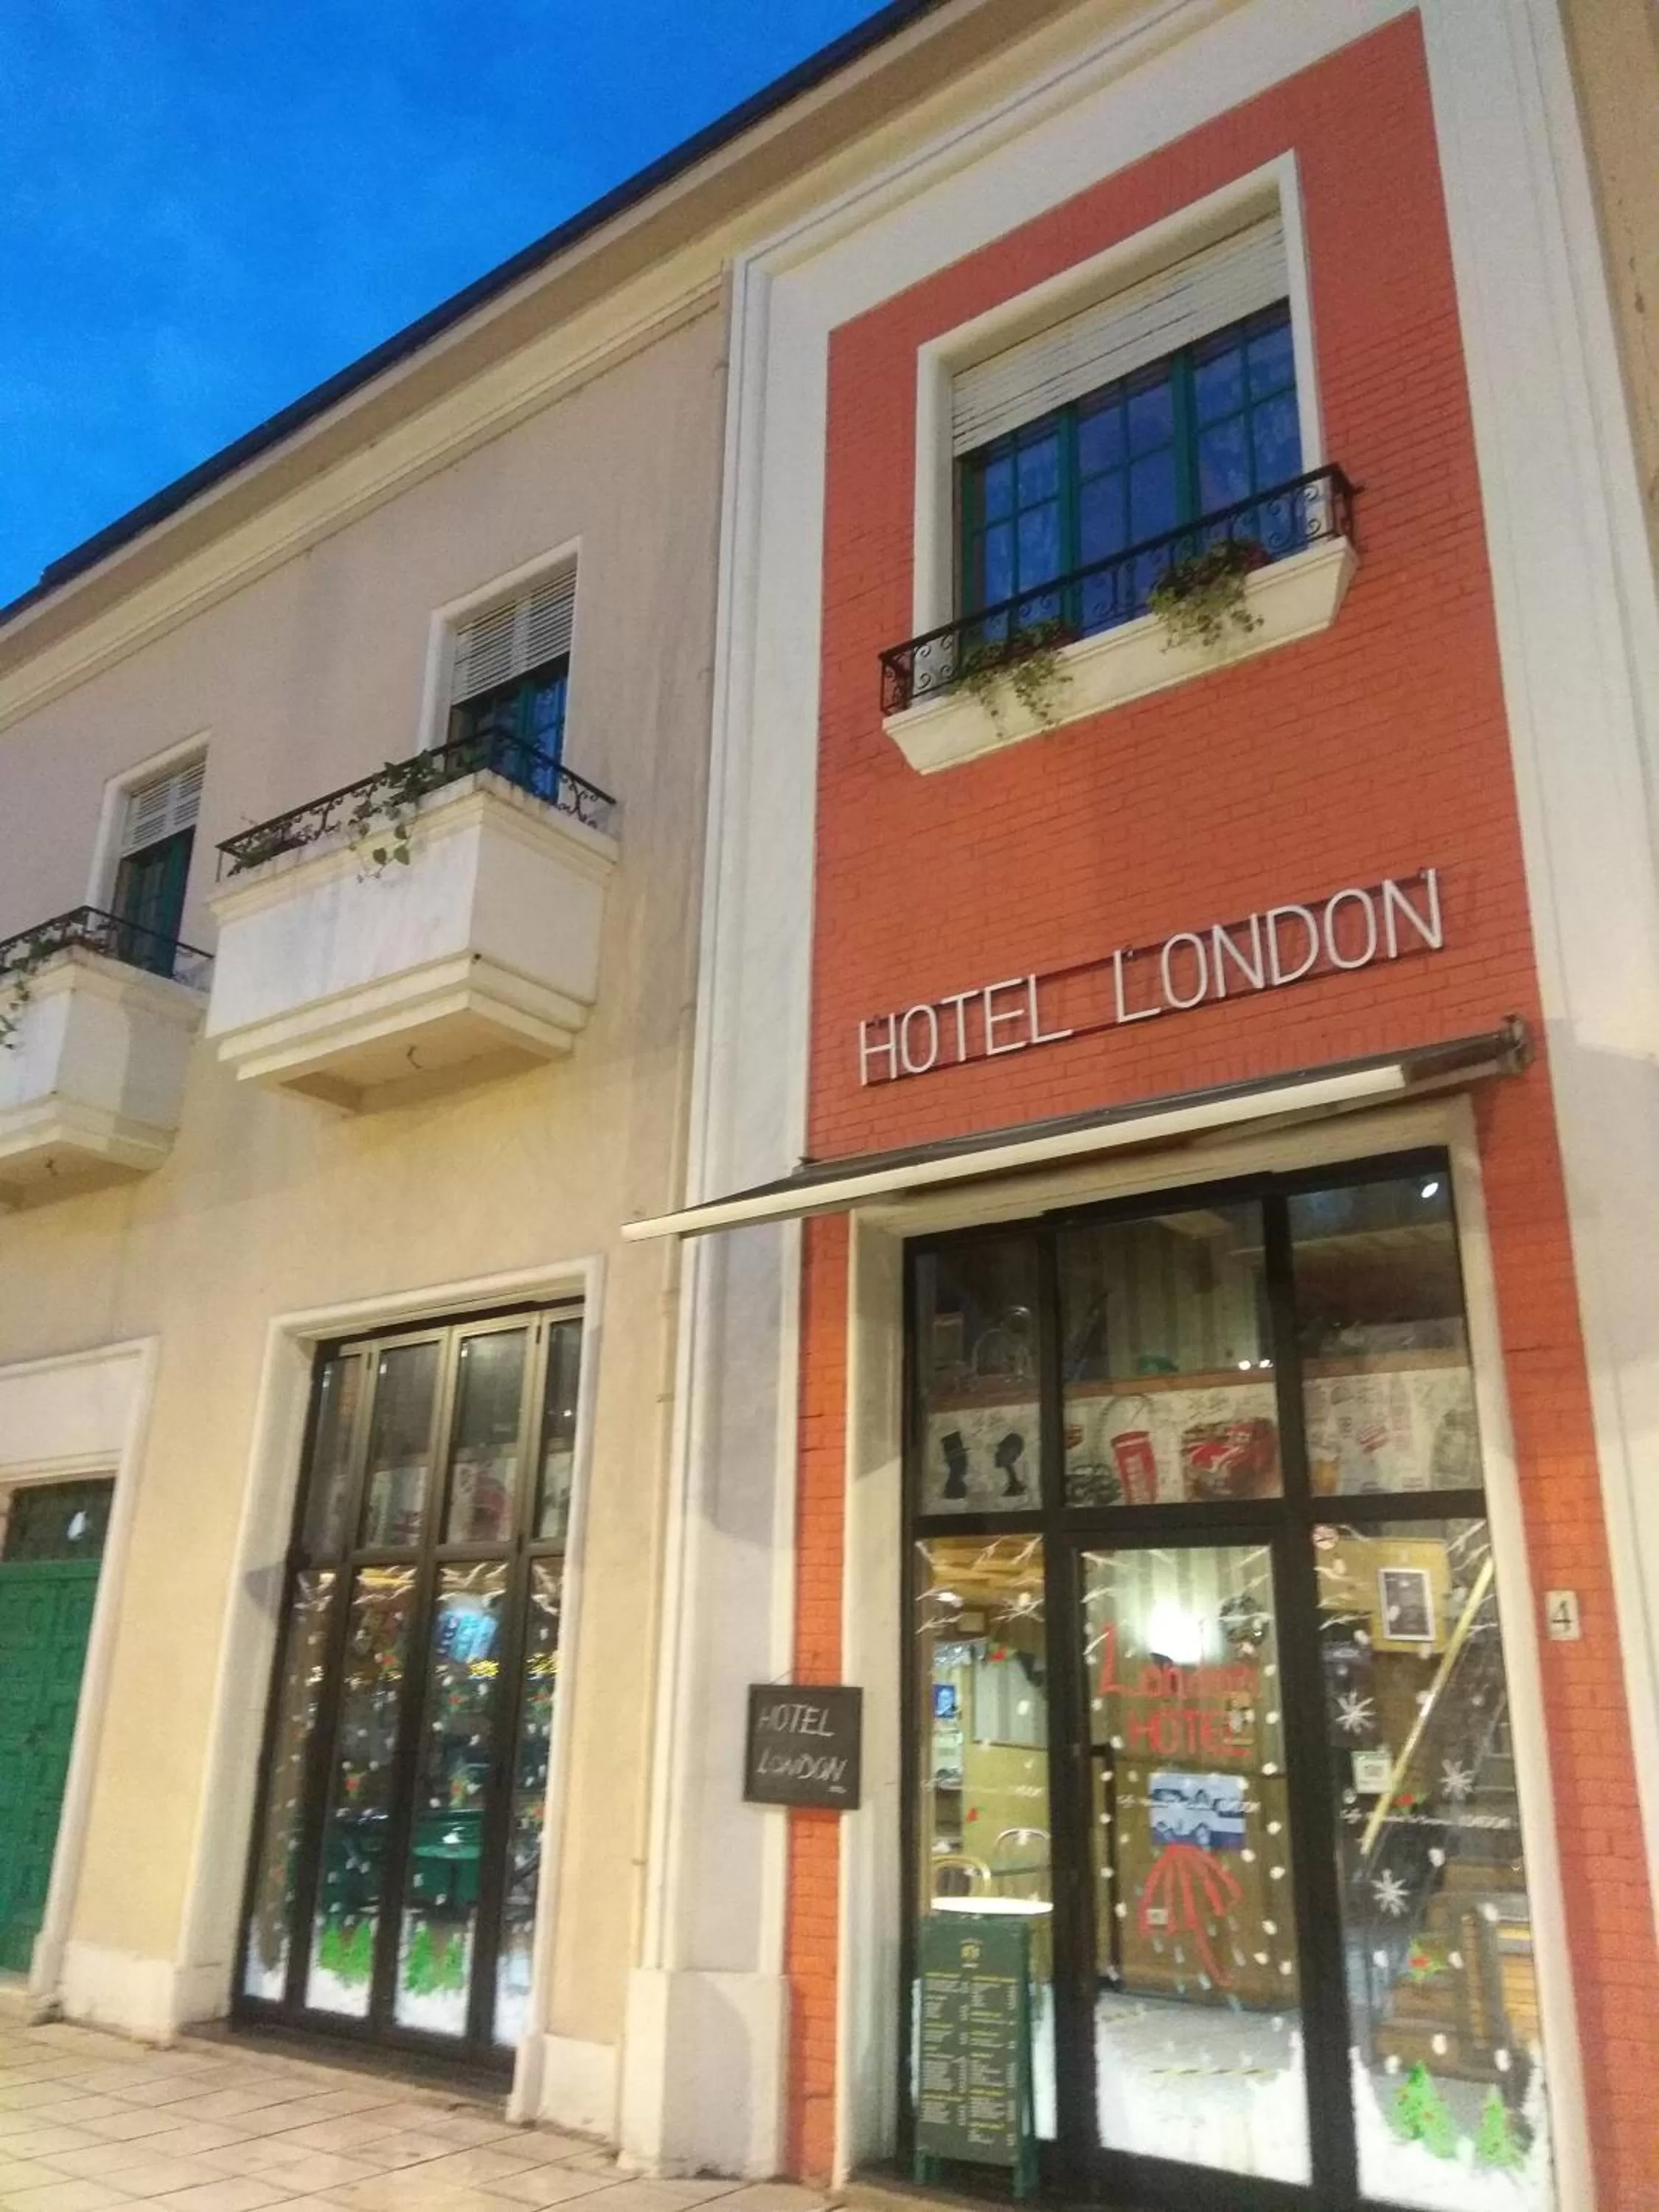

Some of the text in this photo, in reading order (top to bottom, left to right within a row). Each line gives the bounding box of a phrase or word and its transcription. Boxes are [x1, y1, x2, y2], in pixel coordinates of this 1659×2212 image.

[859, 868, 1444, 1086] HOTEL LONDON
[1551, 1599, 1572, 1632] 4
[757, 1703, 835, 1736] HOTEL
